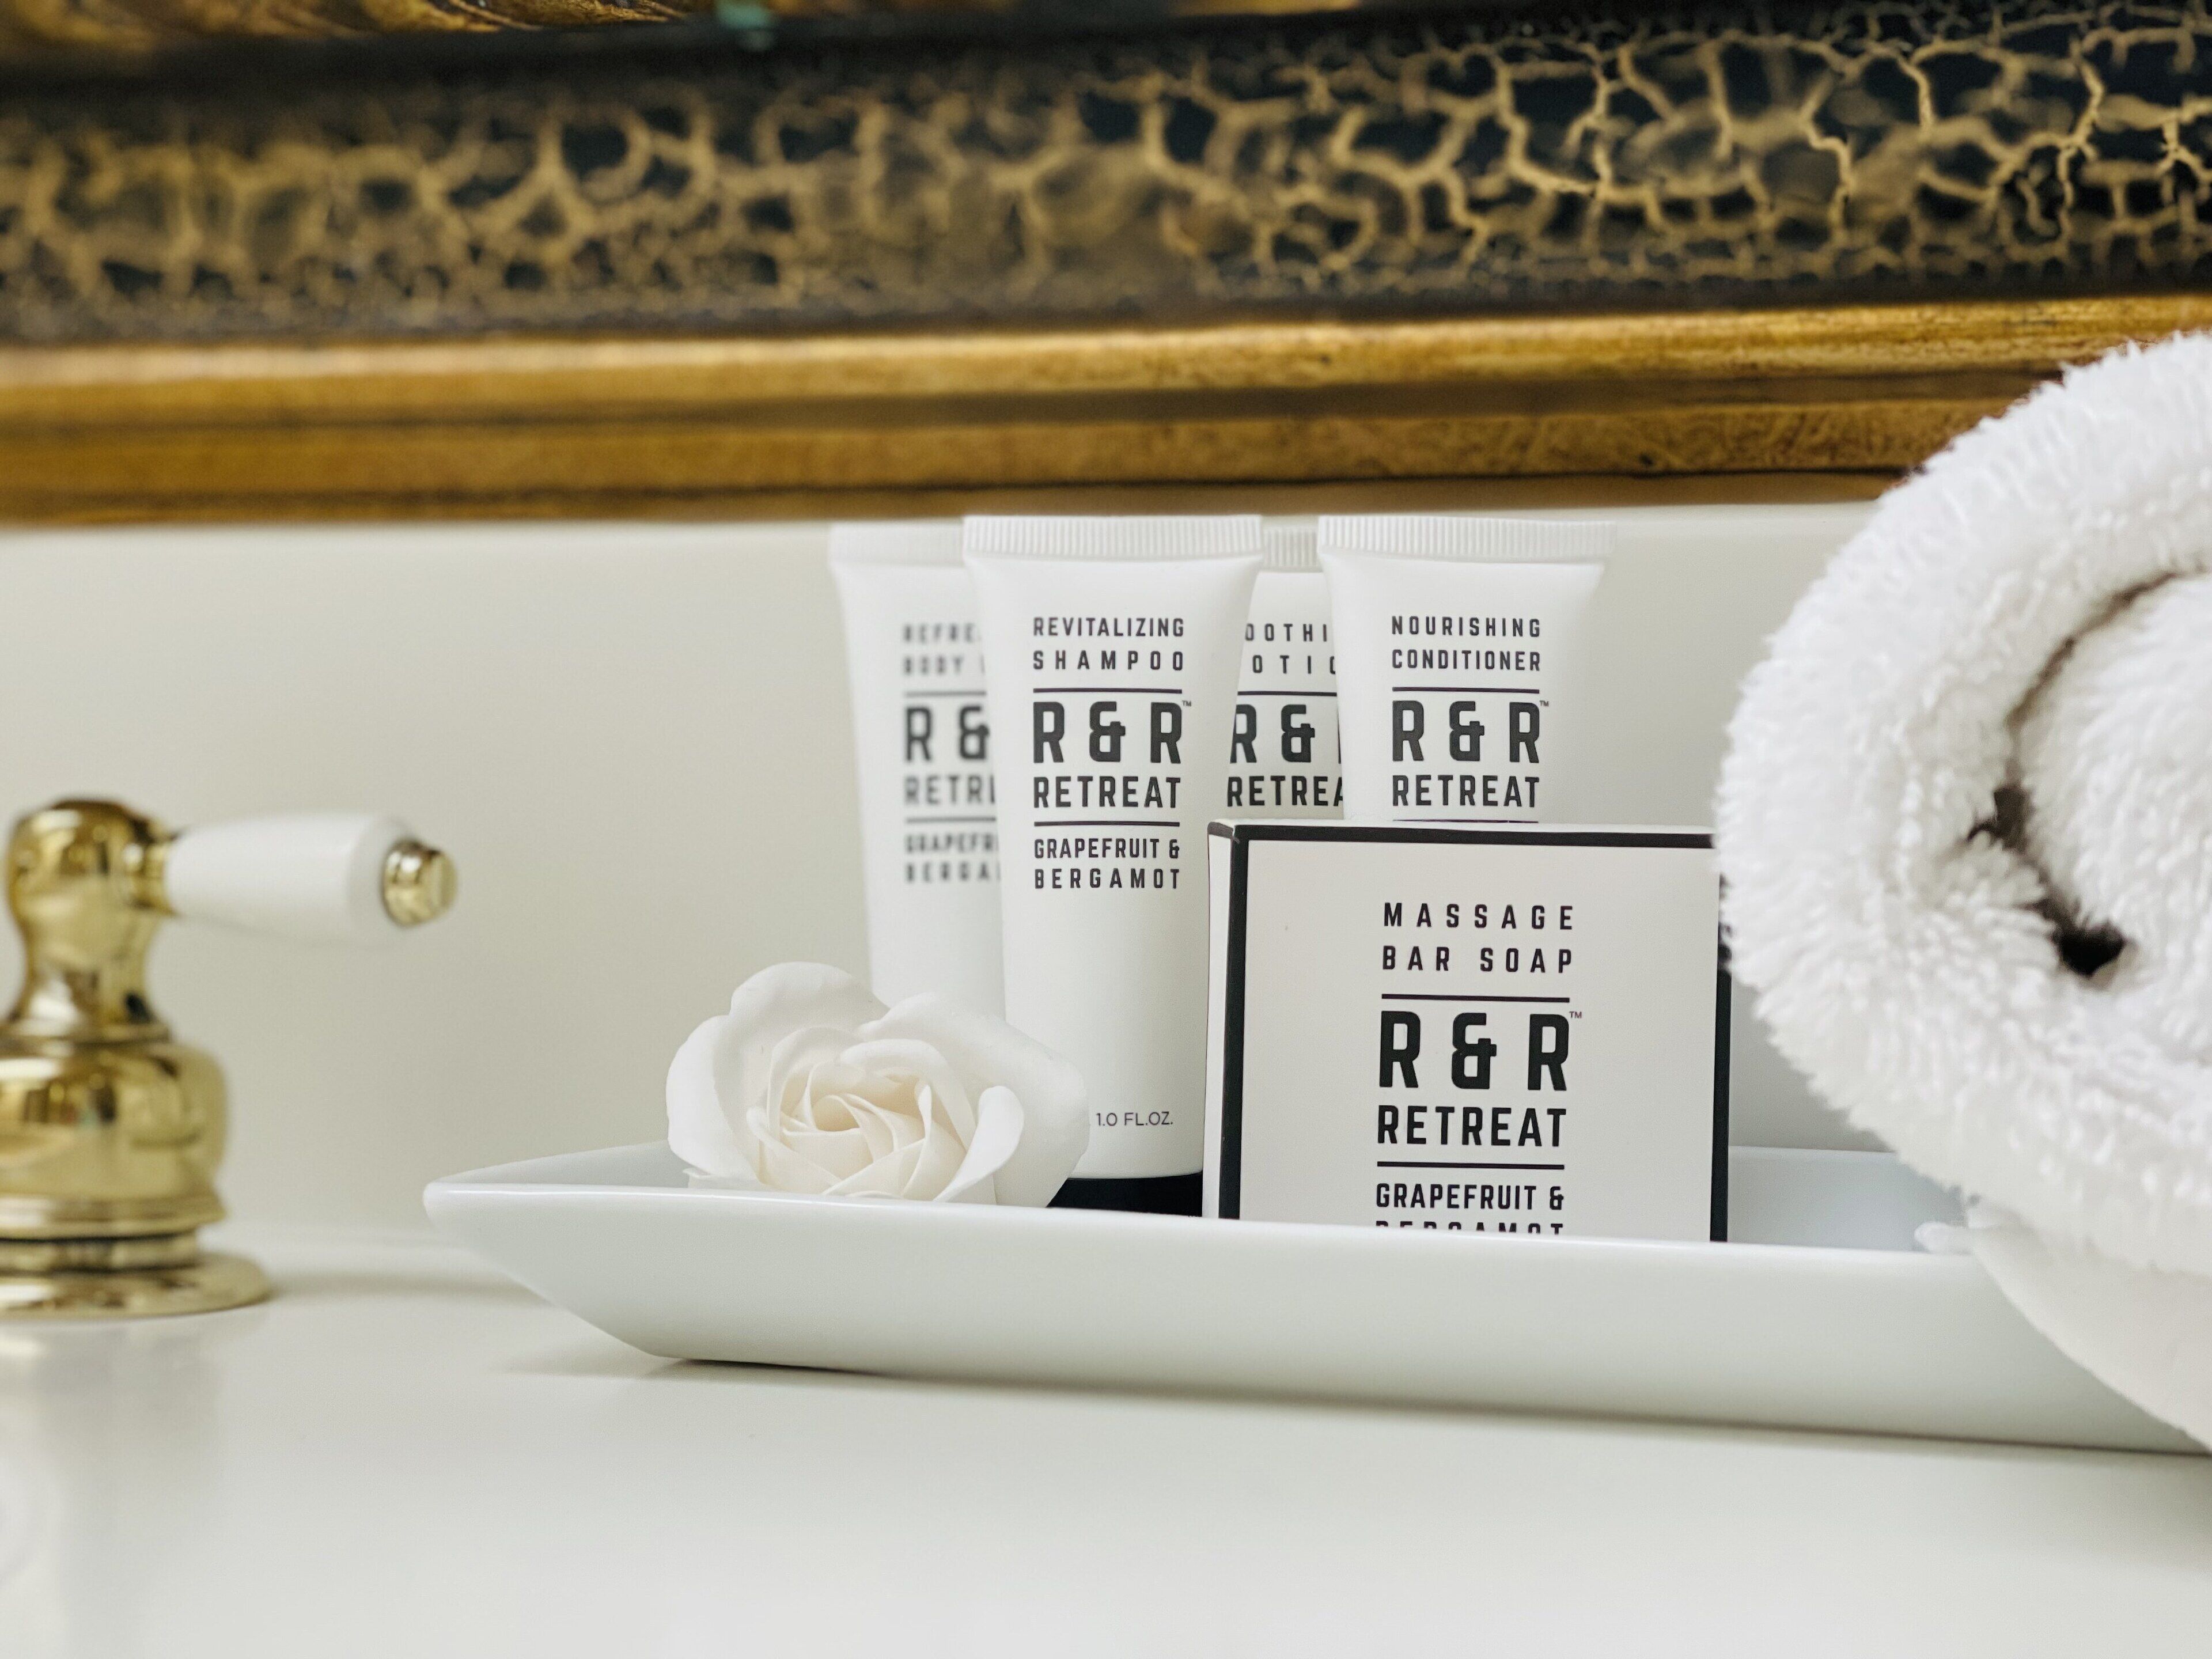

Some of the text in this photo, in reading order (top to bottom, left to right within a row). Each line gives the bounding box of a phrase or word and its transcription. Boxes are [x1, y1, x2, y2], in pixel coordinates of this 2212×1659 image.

[903, 623, 982, 643] REFRE
[1034, 617, 1183, 637] REVITALIZING
[1392, 616, 1540, 638] NOURISHING
[1033, 650, 1183, 671] SHAMPOO
[1392, 649, 1540, 671] CONDITIONER
[905, 704, 990, 762] R &
[1033, 702, 1065, 764] R
[1089, 702, 1126, 763] &
[1230, 704, 1257, 763] R
[1281, 704, 1316, 763] &
[1392, 700, 1424, 762] R
[1449, 701, 1485, 762] &
[1033, 776, 1181, 808] RETREAT
[1392, 774, 1540, 808] RETREAT
[906, 833, 999, 853] GRAPEFR
[1035, 838, 1180, 859] GRAPEFRUIT &
[907, 862, 1000, 882] BERGA
[1035, 868, 1180, 889] BERGAMOT
[1384, 902, 1573, 930] MASSAGE
[1382, 945, 1572, 974] BAR SOAP
[1379, 1010, 1421, 1088] R
[1451, 1012, 1497, 1090] &
[1096, 1111, 1173, 1126] 1.0 FL.OZ.
[1377, 1105, 1567, 1147] RETREAT
[1376, 1183, 1564, 1210] GRAPEFRUIT &
